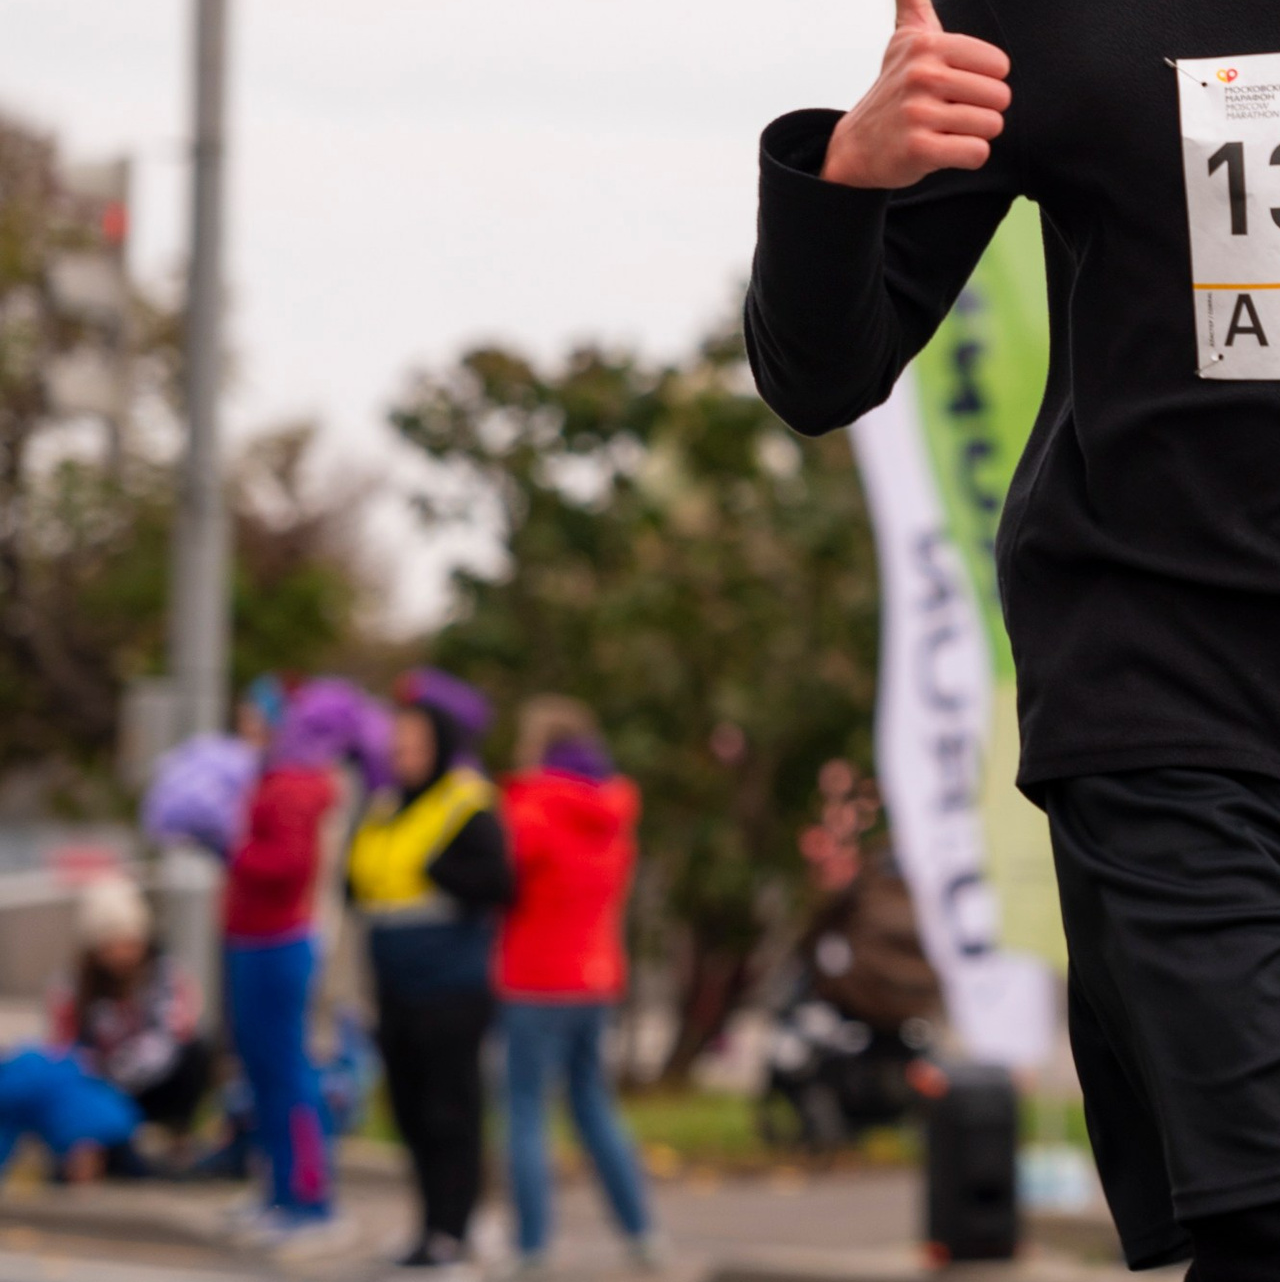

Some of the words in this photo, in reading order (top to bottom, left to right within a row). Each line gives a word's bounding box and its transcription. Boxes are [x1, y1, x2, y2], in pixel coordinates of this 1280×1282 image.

[1225, 93, 1275, 103] МАРАФОН
[1226, 102, 1270, 111] MOSCOW
[1226, 110, 1280, 120] MARATHON
